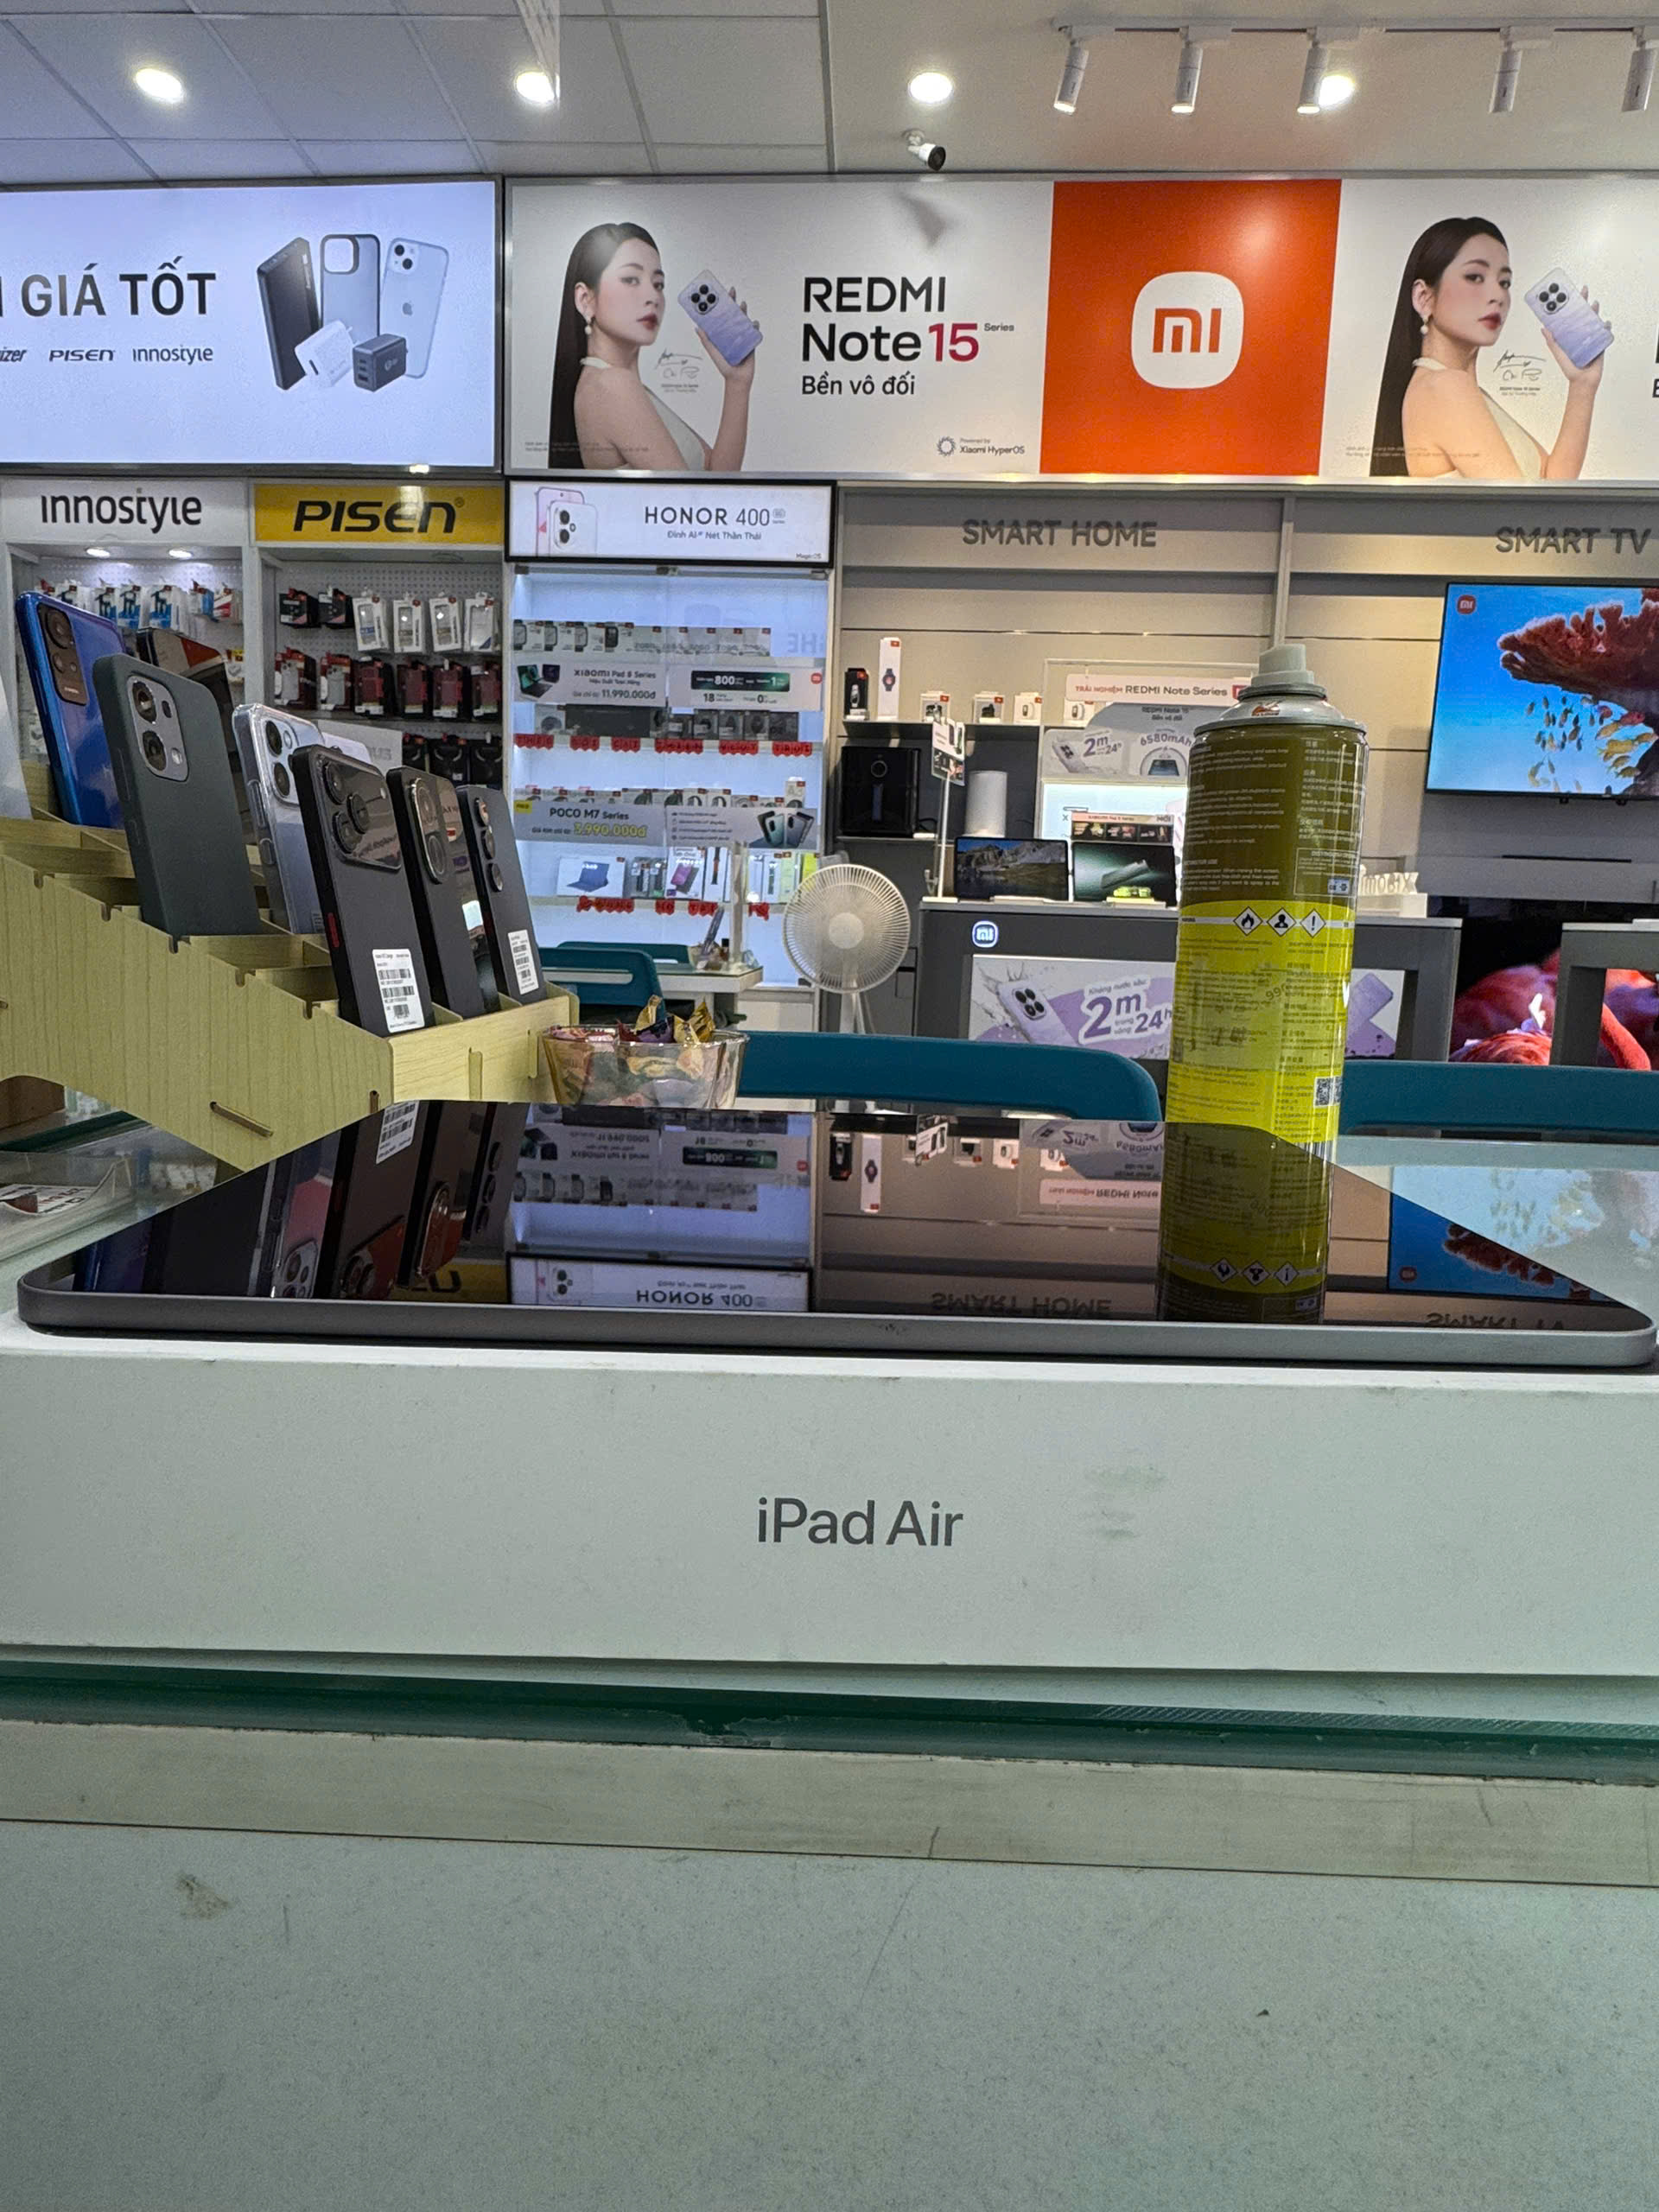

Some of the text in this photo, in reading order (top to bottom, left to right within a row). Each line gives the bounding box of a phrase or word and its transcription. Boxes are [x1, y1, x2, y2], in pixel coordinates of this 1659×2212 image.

[21, 263, 106, 317] GIÁ
[119, 255, 216, 316] TỐT
[804, 276, 946, 313] REDMI
[803, 322, 1014, 362] Note 15 Series
[132, 345, 213, 365] innostyle
[802, 371, 915, 395] Bền vô đối
[988, 445, 1026, 456] HyperOS
[41, 486, 202, 534] innostyle
[645, 506, 728, 525] HONOR
[735, 508, 771, 526] 400
[962, 519, 1158, 547] SMART HOME
[1496, 526, 1652, 555] SMART TV
[714, 675, 734, 686] 800
[1125, 685, 1160, 694] REDMI
[1163, 686, 1190, 696] Note
[1192, 687, 1228, 696] Series
[703, 693, 715, 702] 18
[1140, 734, 1192, 747] 6580mAh
[550, 807, 630, 821] POCO M7 Series
[757, 1496, 963, 1547] iPad Air
